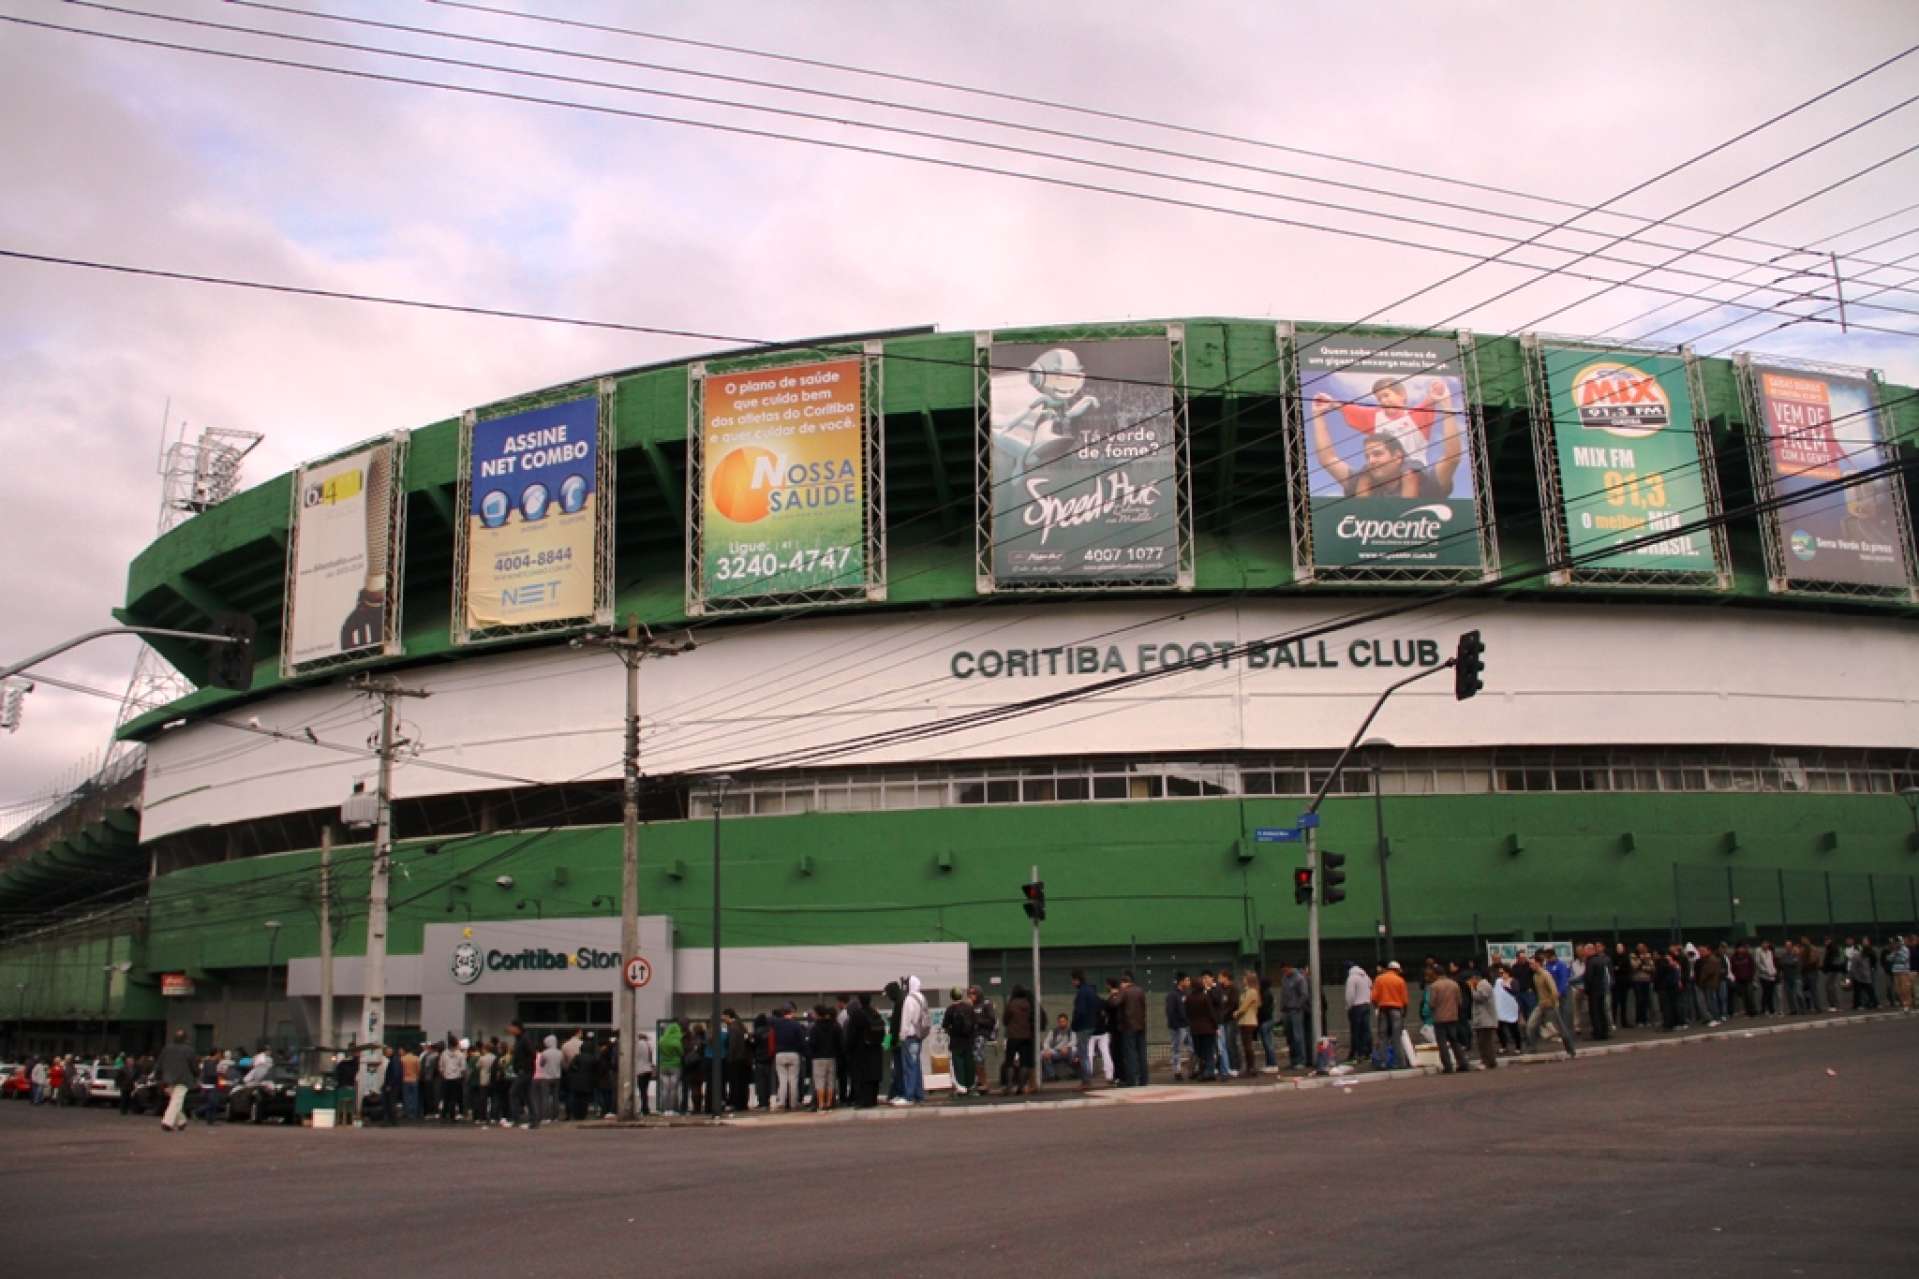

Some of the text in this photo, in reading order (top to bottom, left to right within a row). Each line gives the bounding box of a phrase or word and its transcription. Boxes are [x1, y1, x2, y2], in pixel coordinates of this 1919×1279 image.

[725, 371, 841, 395] O plano de saúde
[1581, 377, 1656, 405] MIX
[733, 388, 833, 412] que cuida bem
[711, 415, 734, 428] dos
[803, 401, 856, 418] Coritiba
[799, 421, 816, 434] de
[1771, 400, 1826, 428] VEM DE
[503, 424, 568, 455] ASSINE
[1106, 426, 1157, 443] verde
[480, 440, 589, 479] NET COMBO
[1077, 441, 1160, 460] de fome?
[1573, 446, 1636, 469] MIX FM
[751, 454, 856, 490] NOSSA
[1023, 473, 1103, 546] Speed
[1581, 511, 1592, 529] O
[1336, 514, 1441, 546] Expoente
[494, 546, 572, 572] 4004-8844
[716, 546, 852, 580] 3240-4747
[1084, 548, 1122, 561] 4007
[502, 580, 561, 607] NET
[951, 638, 1440, 679] CORITIBA FOOT BALL CLUB
[486, 946, 623, 971] Coritiba Stor
